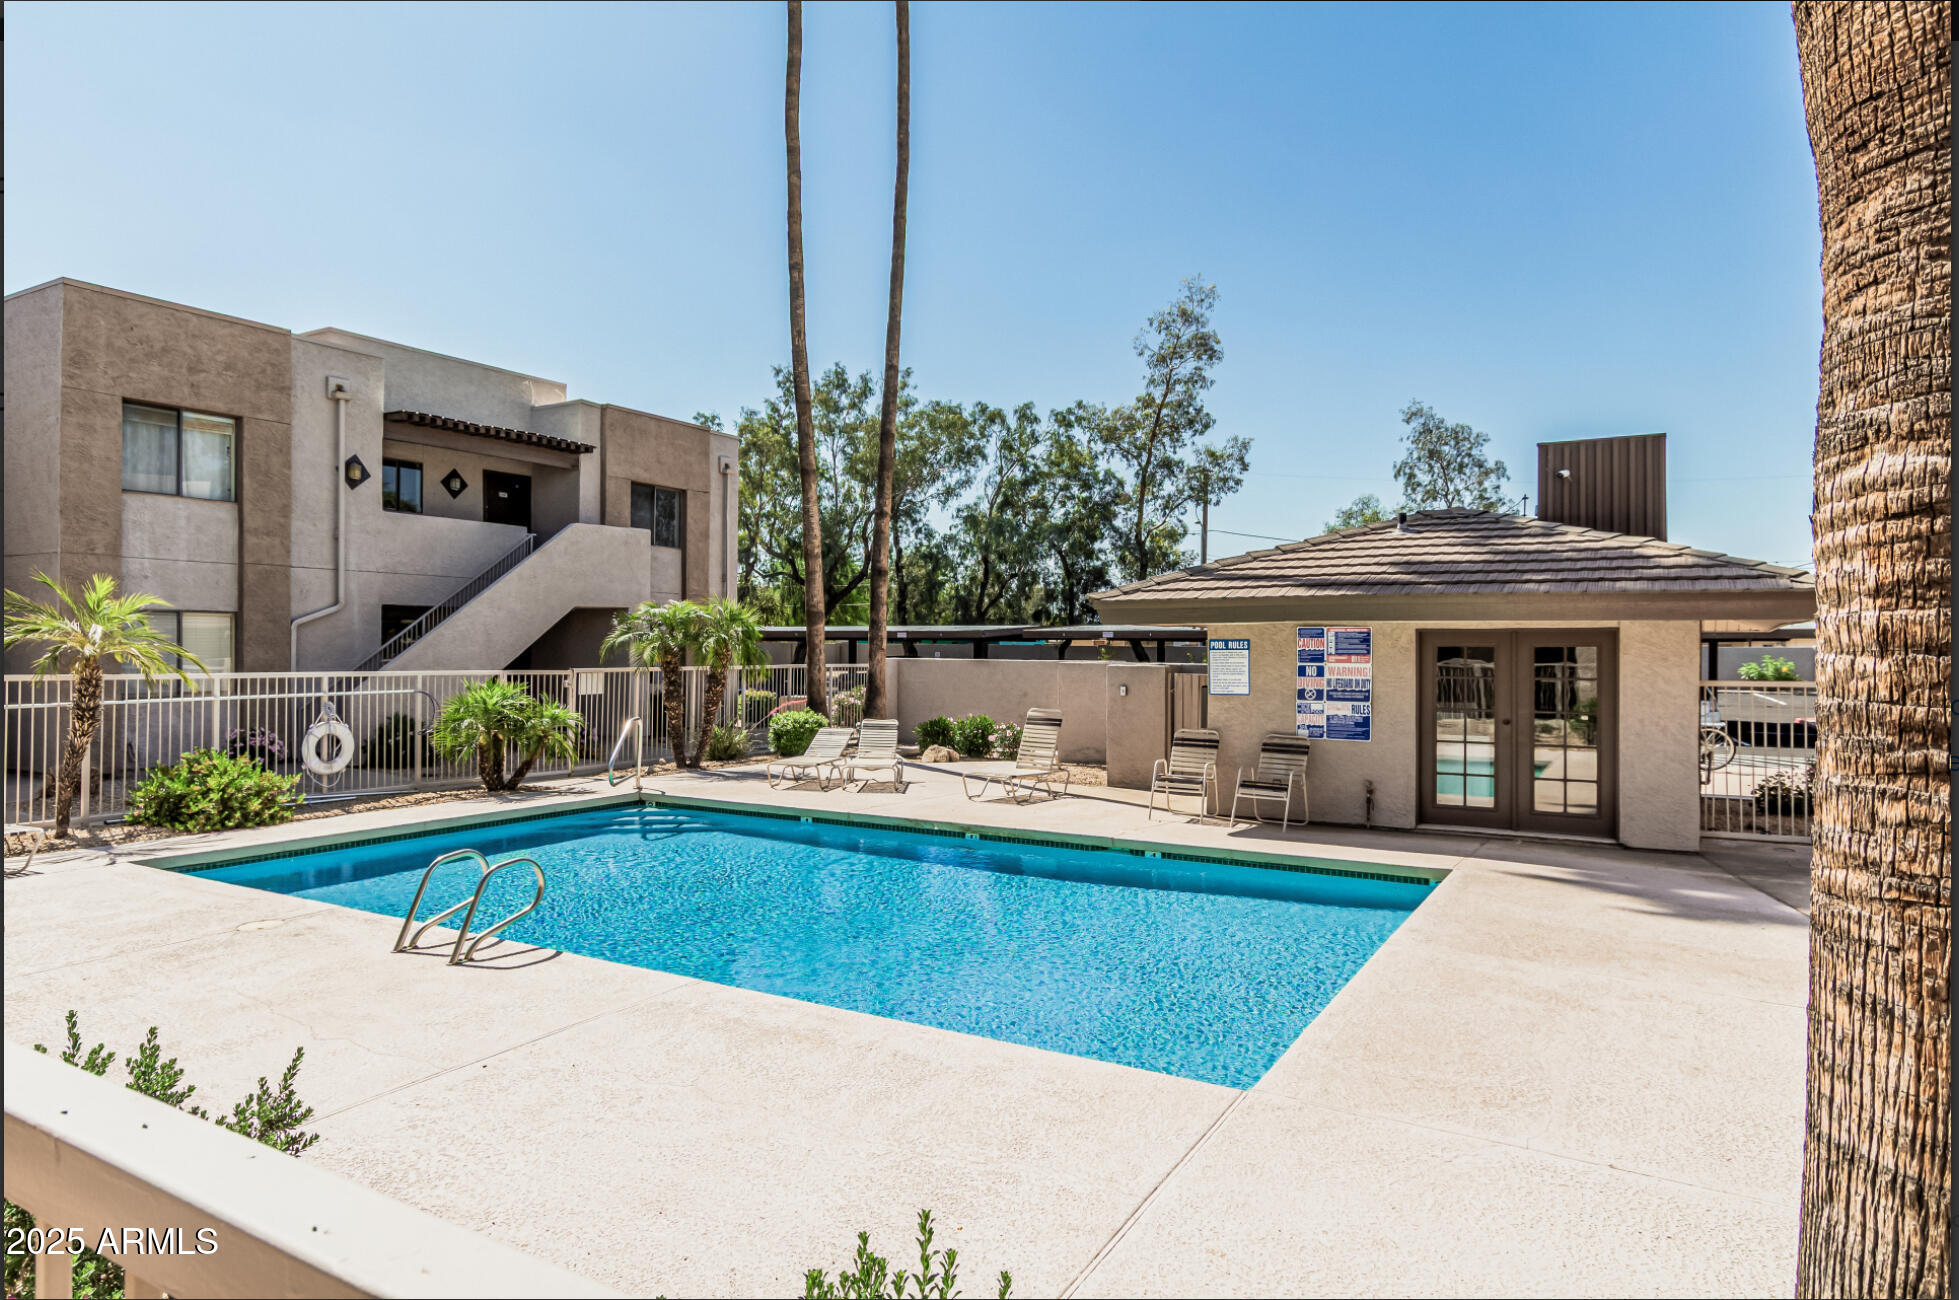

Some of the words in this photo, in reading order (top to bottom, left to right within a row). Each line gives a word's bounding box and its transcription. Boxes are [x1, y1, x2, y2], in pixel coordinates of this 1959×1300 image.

[1210, 641, 1226, 649] POOL
[1228, 641, 1248, 649] RULES
[1297, 638, 1325, 649] CAUTION
[1305, 665, 1317, 677] NO
[1328, 666, 1371, 677] WARNING!
[1297, 677, 1324, 688] DIVING
[1351, 704, 1371, 715] RULES
